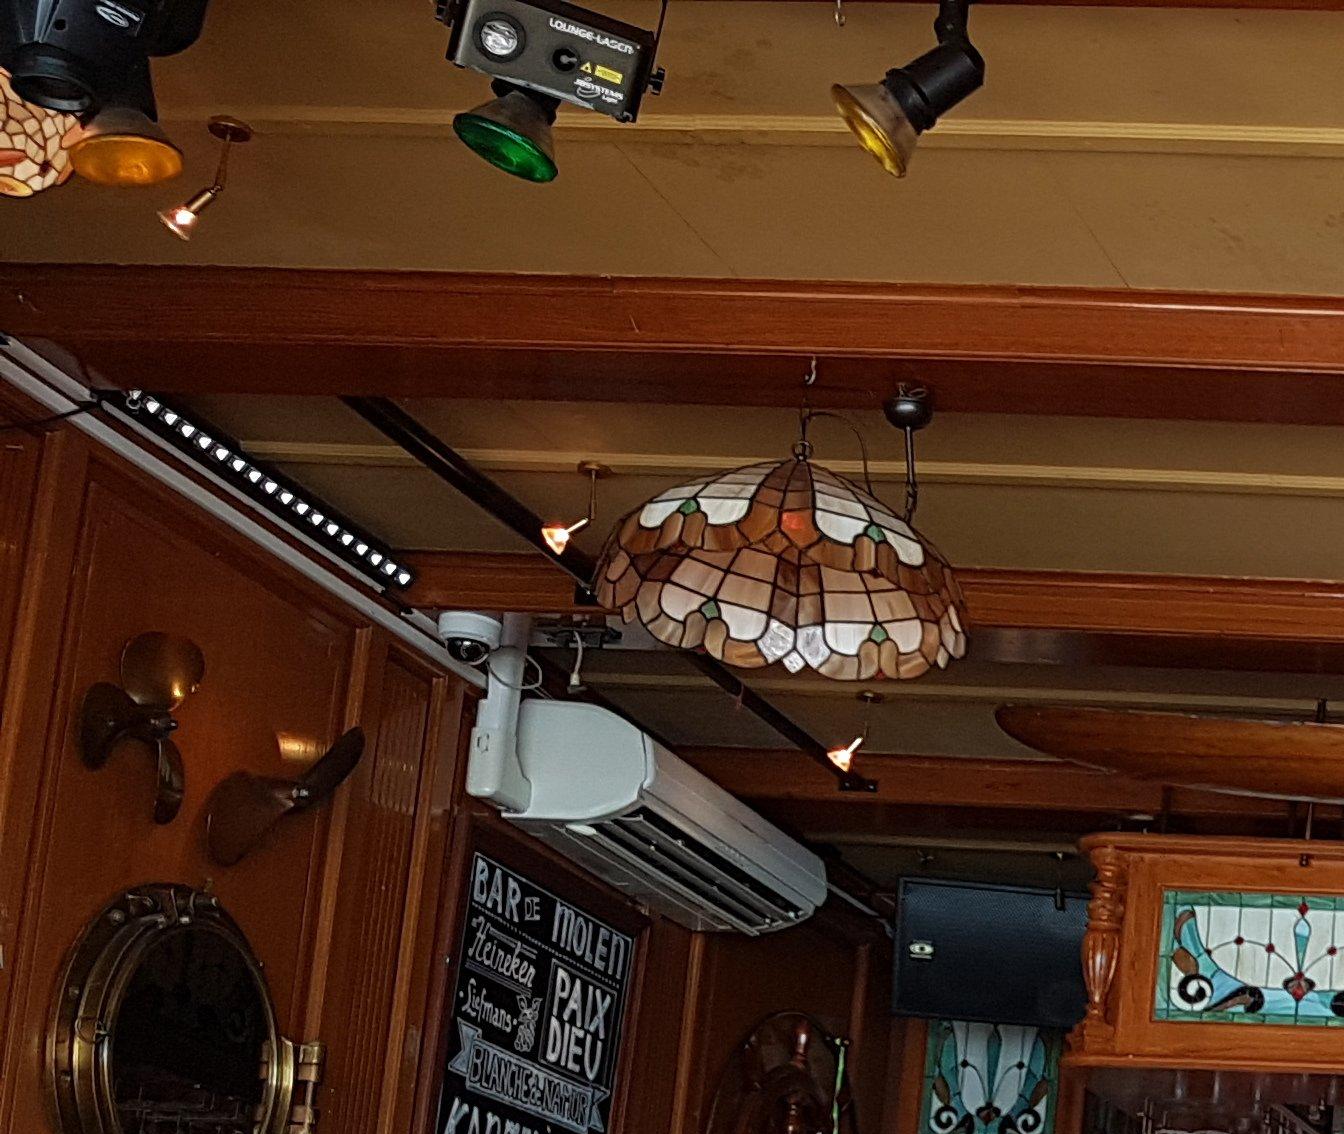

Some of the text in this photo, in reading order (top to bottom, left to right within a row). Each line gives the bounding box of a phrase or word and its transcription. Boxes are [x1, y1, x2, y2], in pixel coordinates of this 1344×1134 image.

[468, 915, 537, 988] Heineken
[474, 857, 626, 980] BAR DE MOLEN
[461, 977, 513, 1033] Liefmans
[553, 967, 612, 1039] PAIX
[469, 1044, 533, 1105] BLANCHE
[545, 1015, 603, 1081] DIEU
